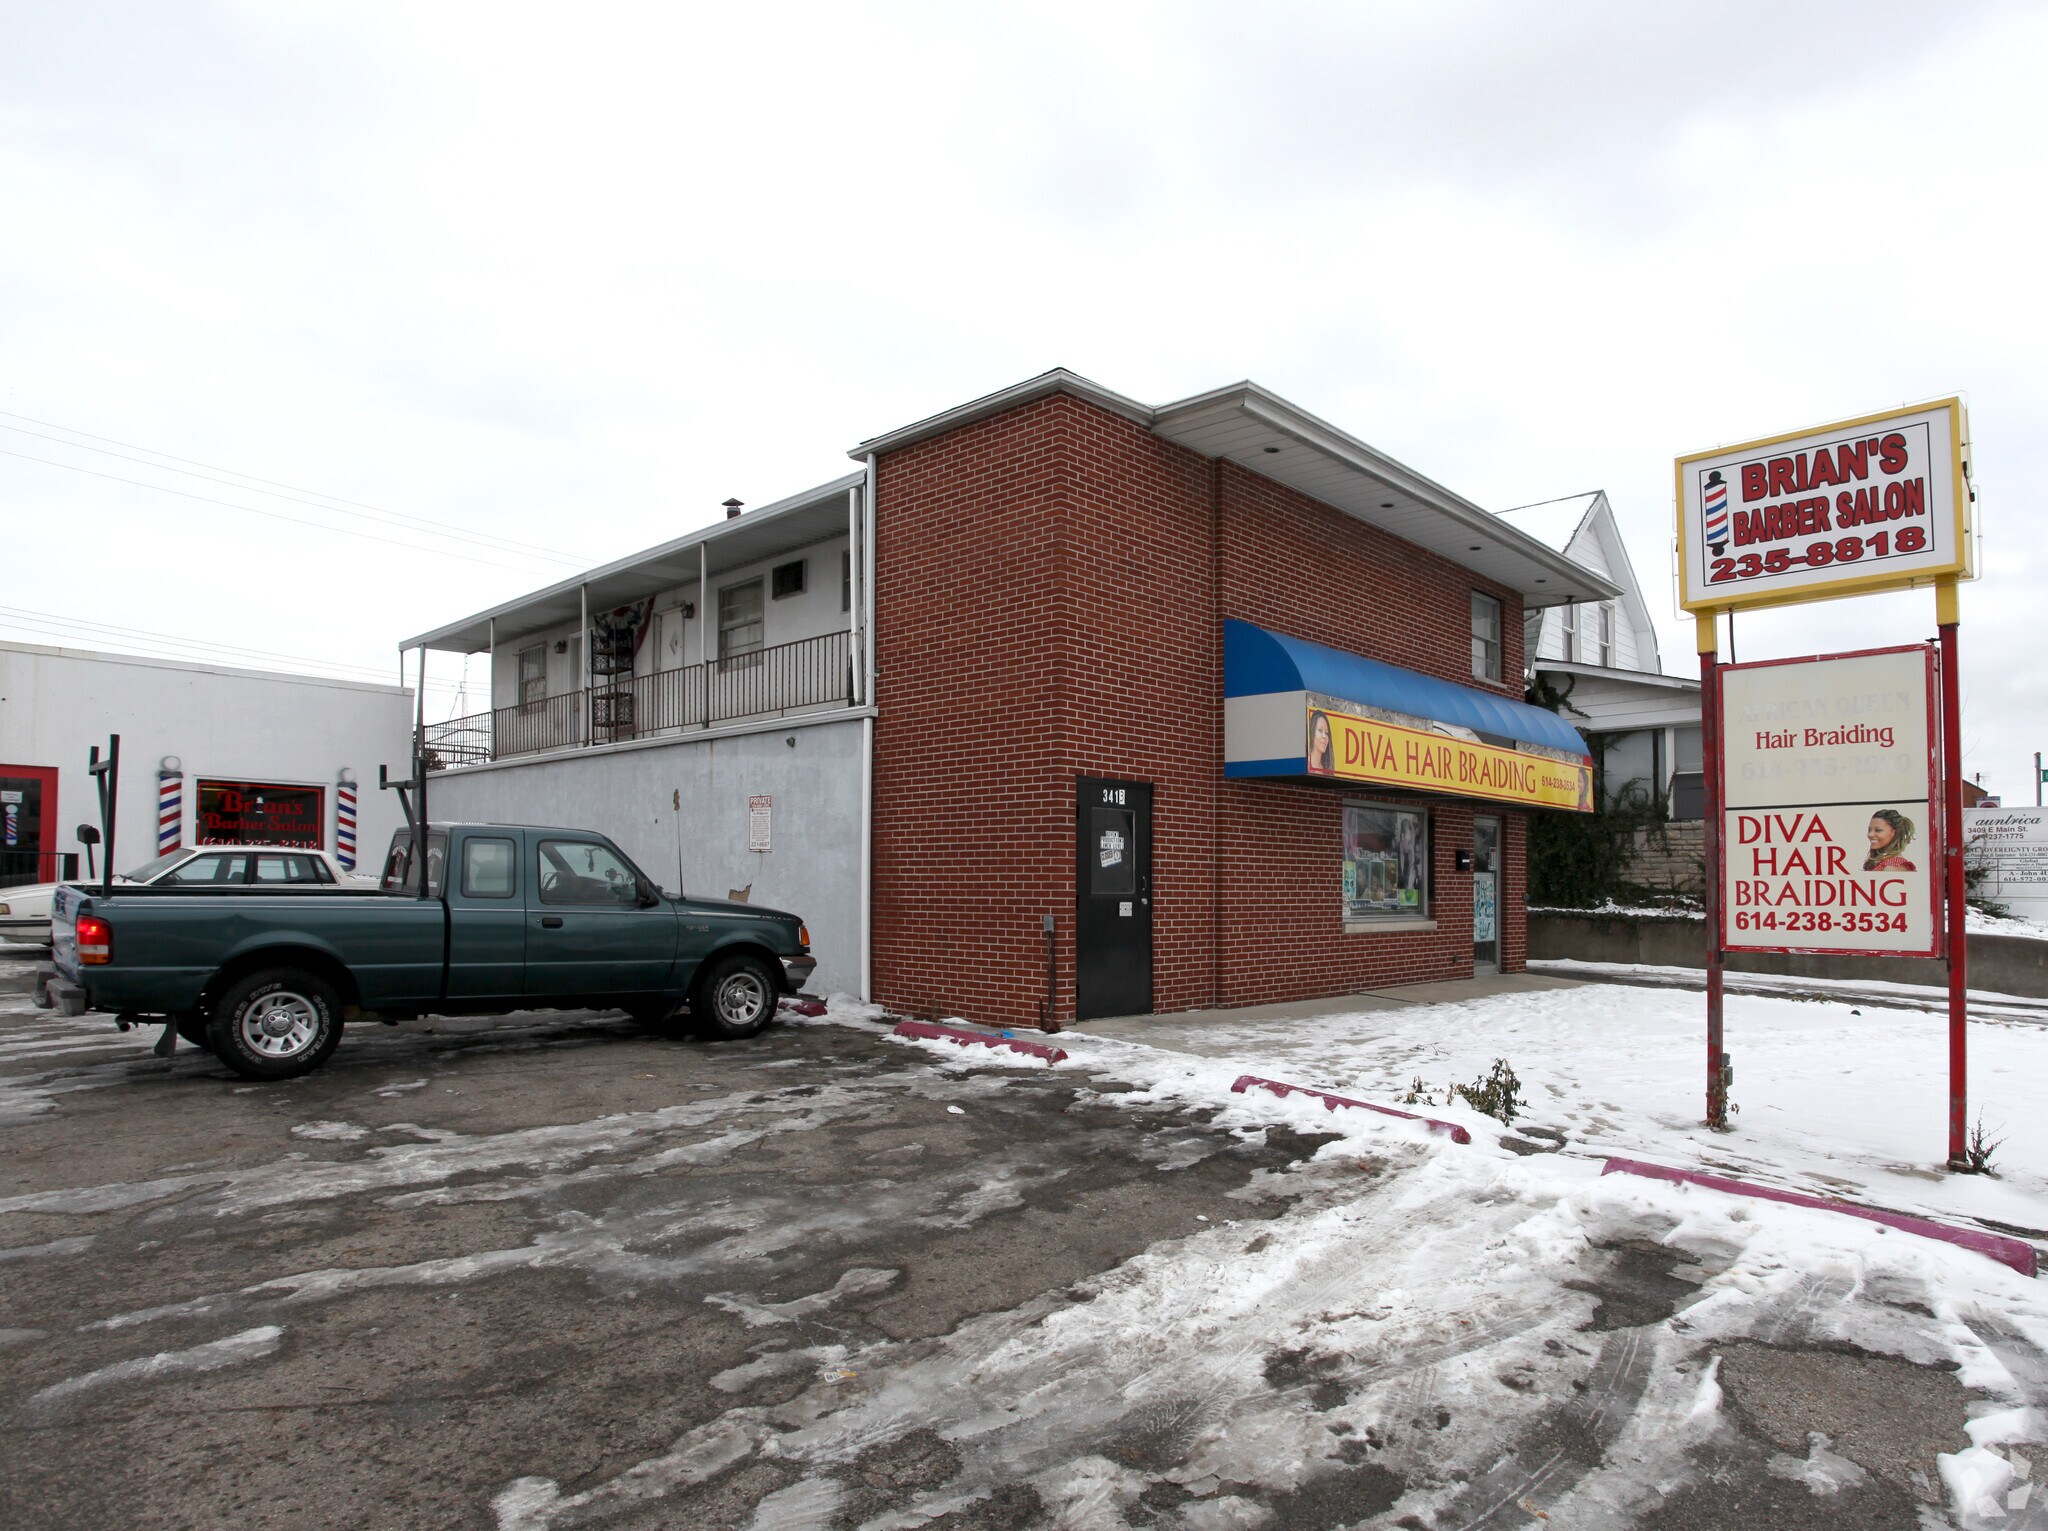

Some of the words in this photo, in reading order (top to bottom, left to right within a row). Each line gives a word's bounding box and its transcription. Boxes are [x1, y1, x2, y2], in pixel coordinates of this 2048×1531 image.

[1741, 433, 1909, 503] BRIAN'S
[1733, 495, 1831, 547] BARBER
[1836, 477, 1926, 528] SALON
[1710, 526, 1927, 583] 235-8818
[1756, 728, 1798, 750] Hair
[1804, 723, 1895, 748] Braiding
[1345, 727, 1398, 772] DIVA
[1405, 740, 1454, 780] HAIR
[1459, 750, 1536, 794] BRAIDING
[1541, 775, 1576, 792] 614-238-3534
[204, 812, 265, 830] Barber
[267, 815, 318, 832] Salon
[1738, 813, 1832, 844] DIVA
[1752, 845, 1851, 876] HAIR
[1735, 878, 1908, 907] BRAIDING
[1735, 911, 1908, 932] 614-238-3534
